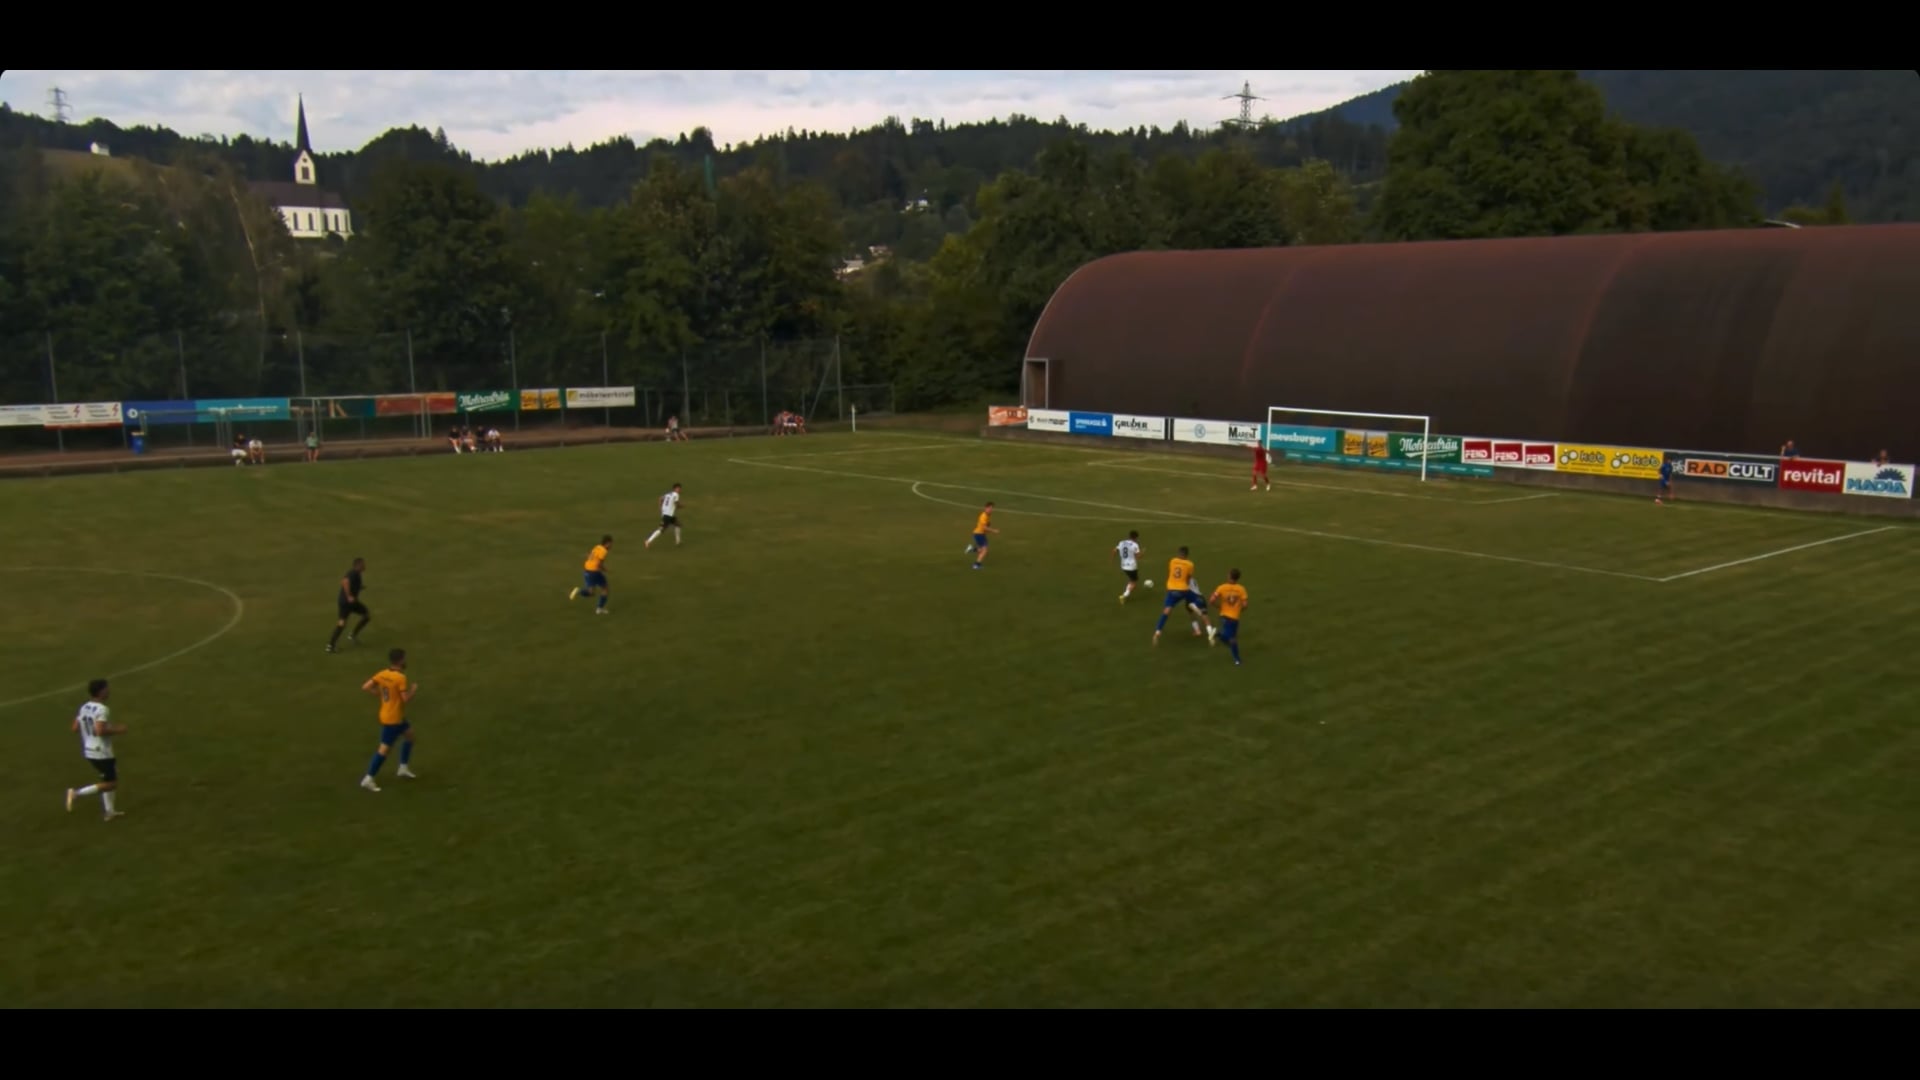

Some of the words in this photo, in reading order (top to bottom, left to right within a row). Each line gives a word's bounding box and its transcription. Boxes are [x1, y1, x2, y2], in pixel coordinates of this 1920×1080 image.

[1400, 437, 1459, 452] Mohenbräu
[1784, 468, 1841, 485] revital
[1122, 547, 1129, 559] 8
[1174, 567, 1182, 579] 3
